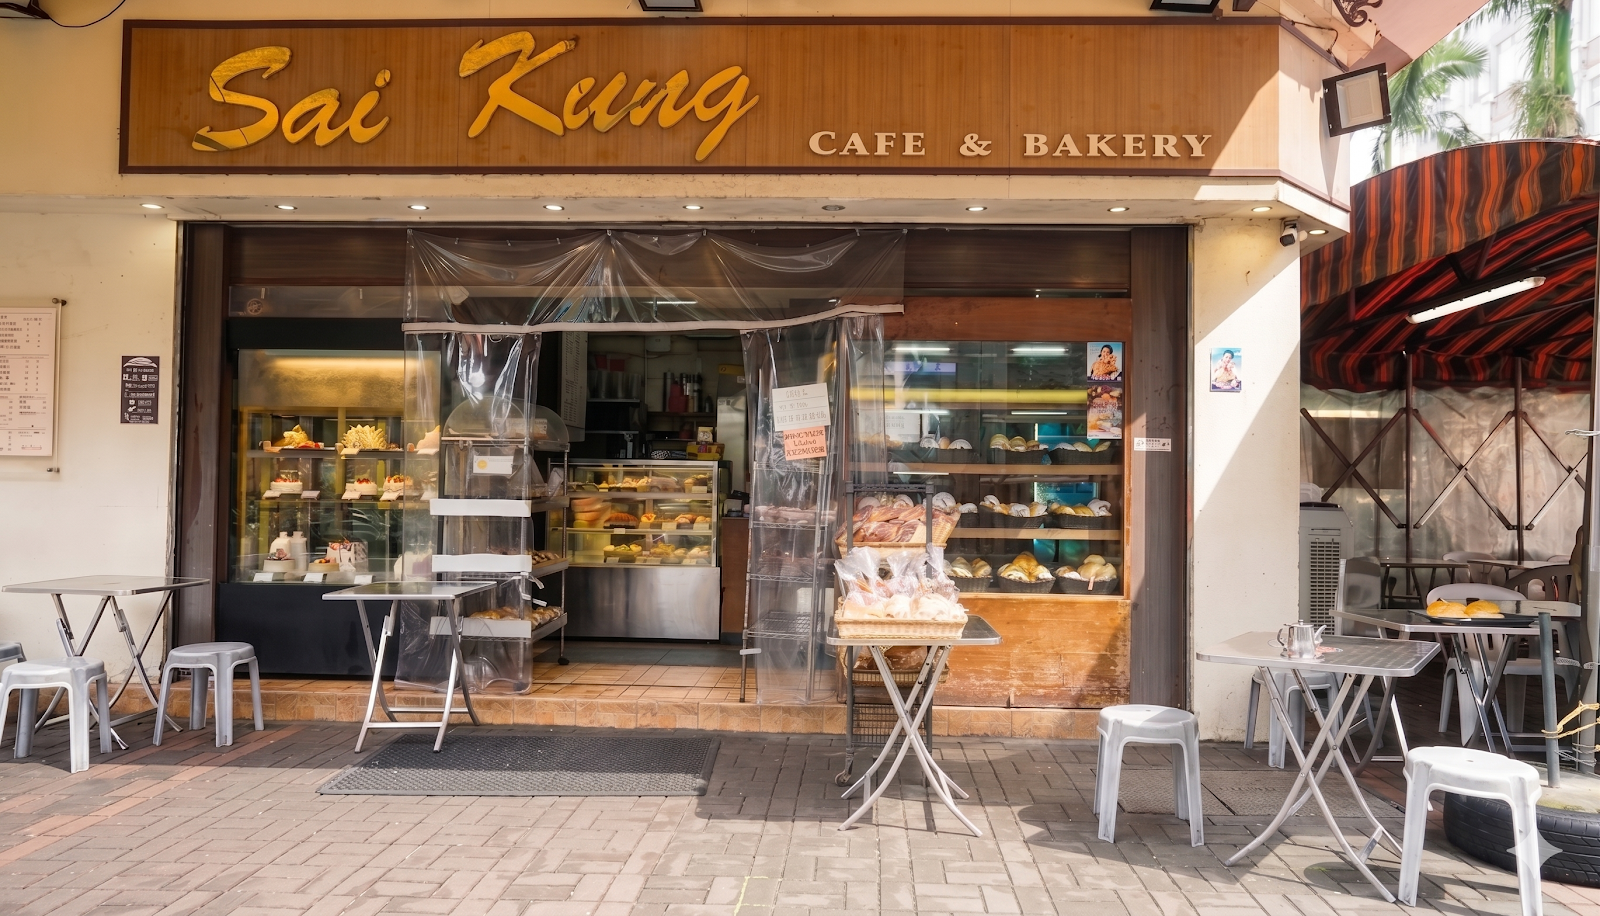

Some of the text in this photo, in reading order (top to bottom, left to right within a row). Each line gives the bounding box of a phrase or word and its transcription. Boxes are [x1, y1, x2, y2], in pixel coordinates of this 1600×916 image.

[191, 30, 759, 162] Sai Kung
[808, 131, 1212, 158] CAFE & BAKERY
